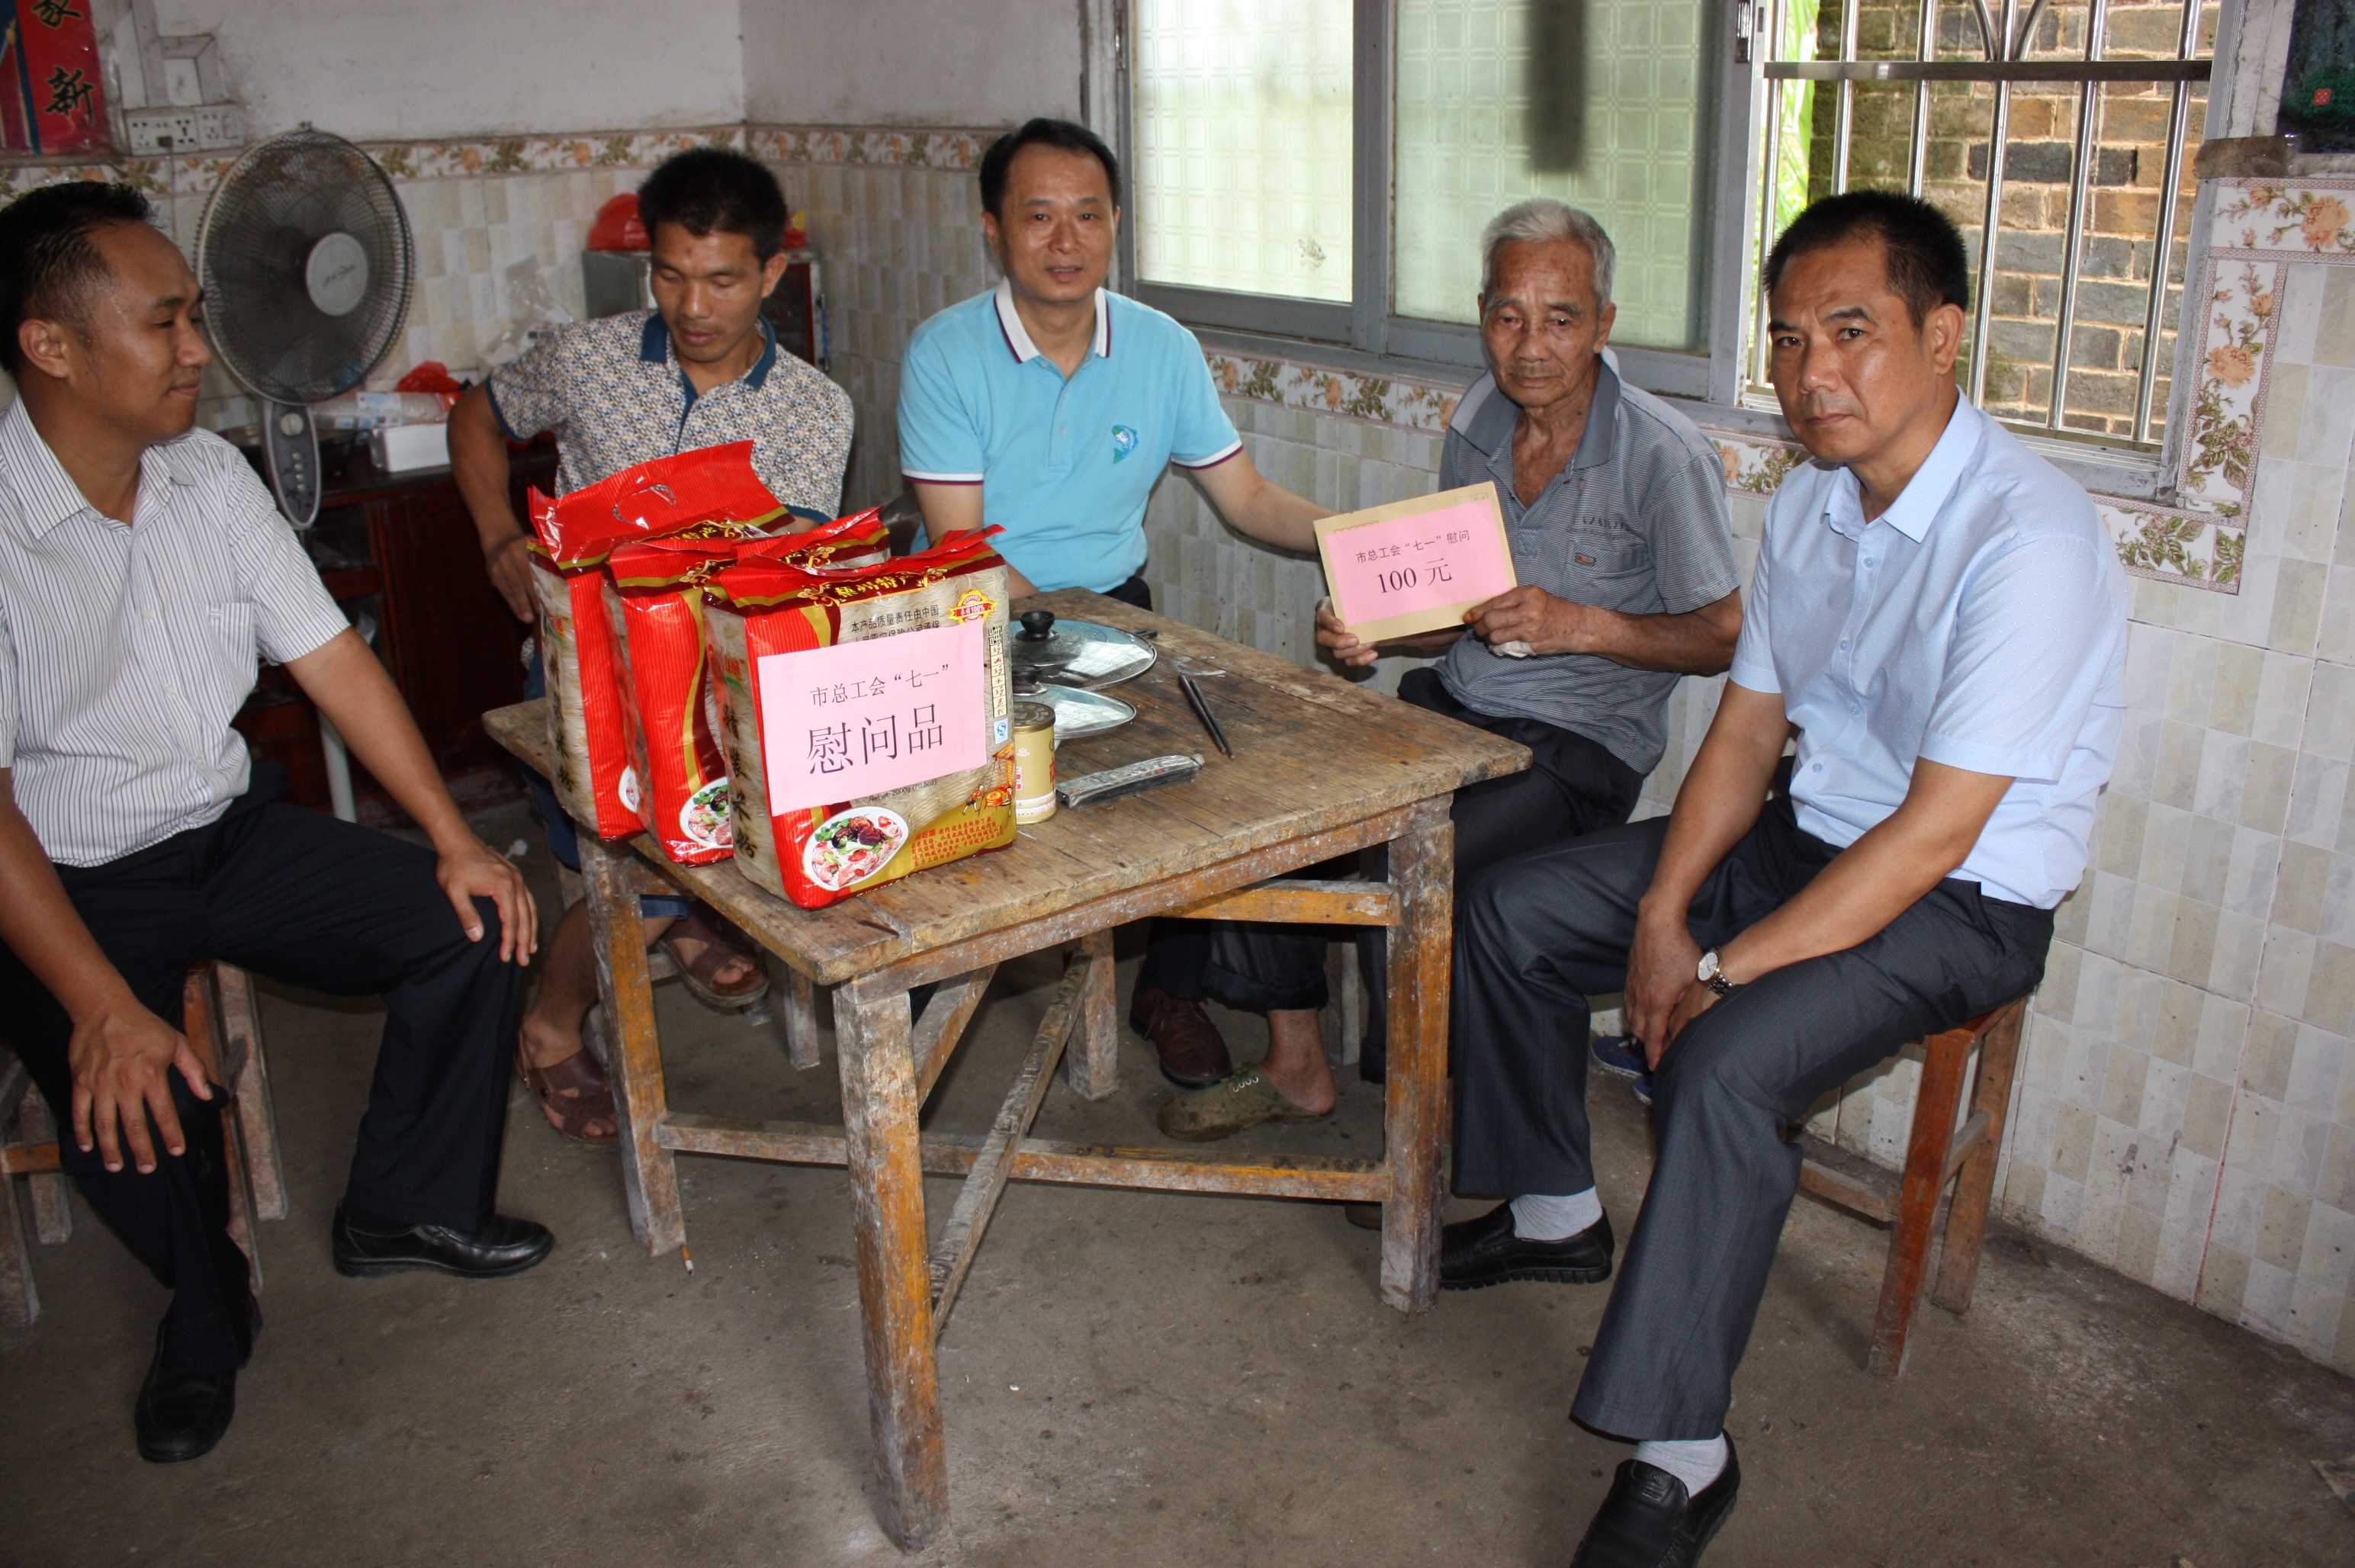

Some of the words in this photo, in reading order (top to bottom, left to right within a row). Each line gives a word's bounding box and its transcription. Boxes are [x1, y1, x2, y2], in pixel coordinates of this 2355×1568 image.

[1356, 530, 1470, 564] 市总工会“七一”慰问
[1377, 567, 1417, 593] 100
[1425, 557, 1453, 586] 元
[851, 605, 939, 633] 本产品质量责任由中国
[810, 664, 949, 706] 市总工会“七一”
[806, 704, 943, 774] 慰问品
[892, 786, 911, 797] 2000g
